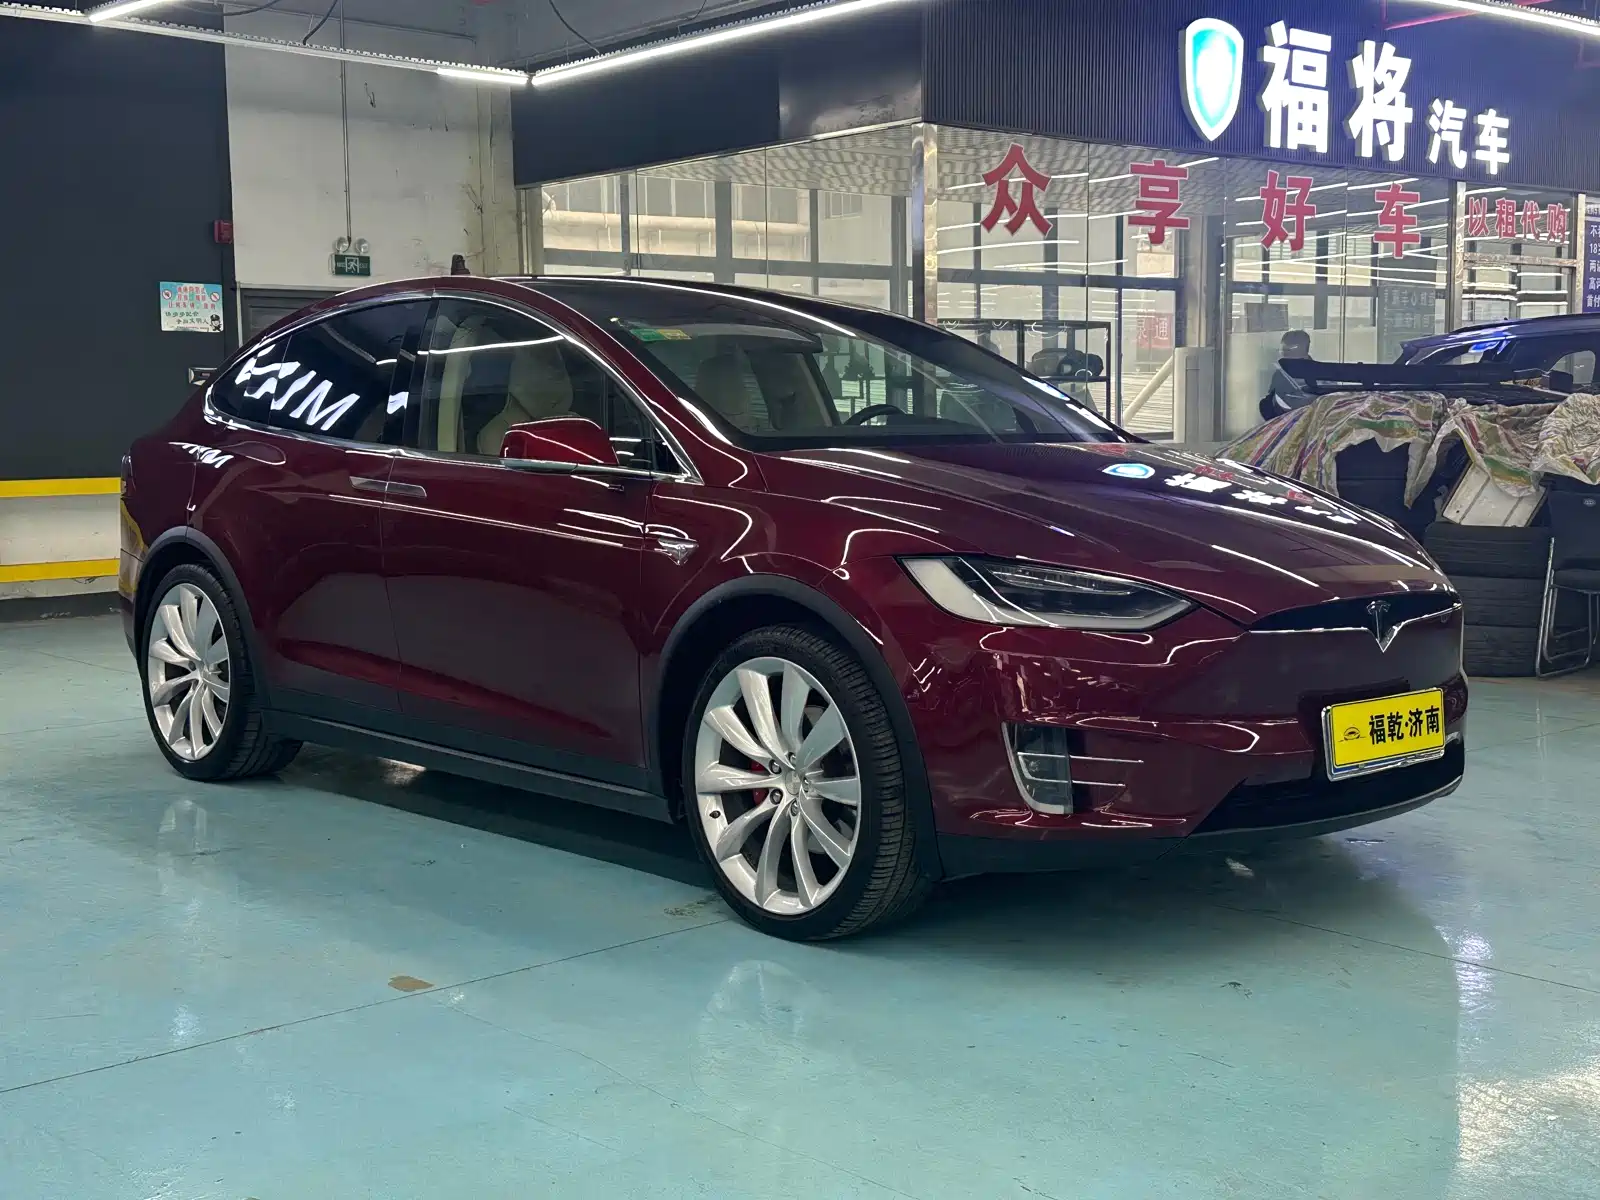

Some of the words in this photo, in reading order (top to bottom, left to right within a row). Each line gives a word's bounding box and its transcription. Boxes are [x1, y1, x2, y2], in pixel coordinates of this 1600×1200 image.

[1260, 20, 1510, 175] 福将汽车
[1468, 197, 1568, 243] 以租代购
